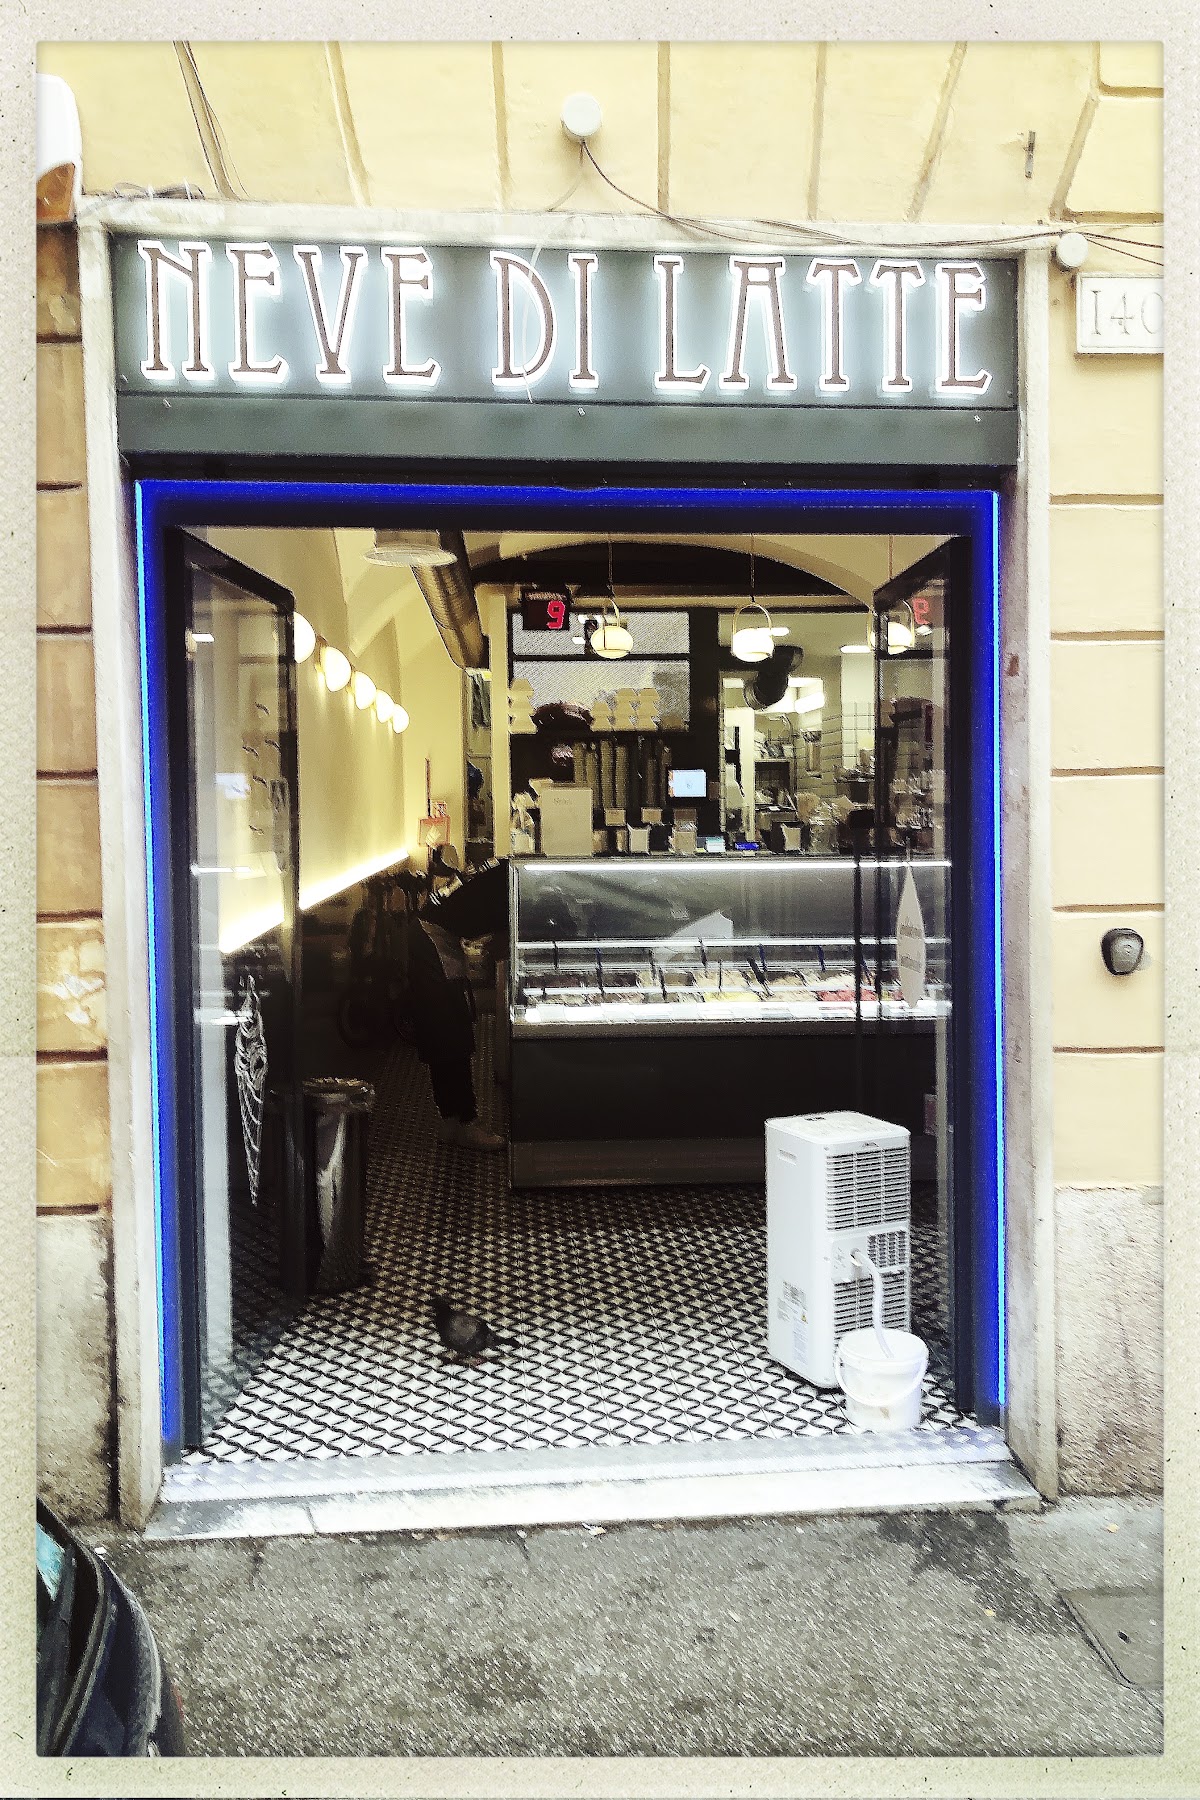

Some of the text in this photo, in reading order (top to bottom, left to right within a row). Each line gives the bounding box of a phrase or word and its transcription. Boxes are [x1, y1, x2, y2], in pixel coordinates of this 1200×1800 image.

[137, 240, 993, 396] NEVE DI LATTE
[1090, 288, 1164, 336] 140
[546, 599, 566, 629] 9
